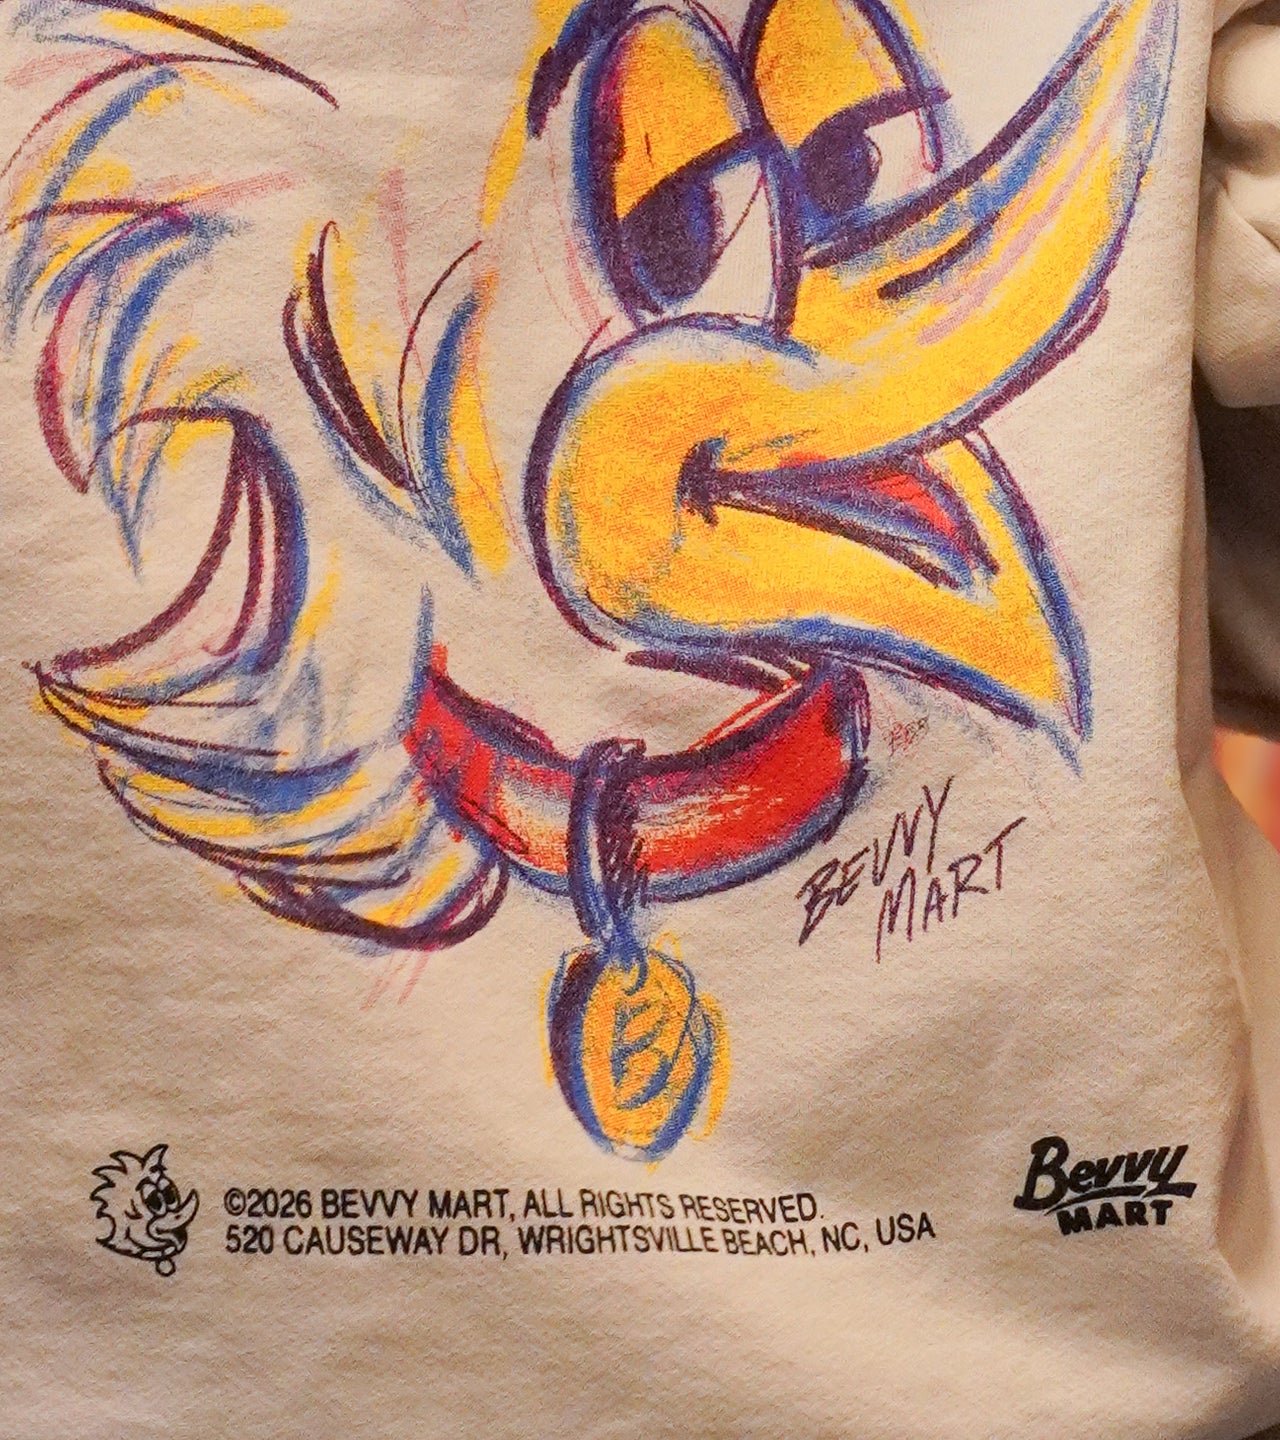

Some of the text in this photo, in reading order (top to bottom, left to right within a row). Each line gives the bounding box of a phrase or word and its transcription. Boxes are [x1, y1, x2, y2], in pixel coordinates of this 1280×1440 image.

[875, 816, 1027, 964] MART
[1013, 1135, 1197, 1215] Bevvy
[223, 1187, 825, 1224] ©2026 BEVVY MART, ALL RIGHTS RESERVED.
[1056, 1199, 1174, 1237] MART
[225, 1211, 937, 1261] 520 CAUSEWAY DR, WRIGHTSVILLE BEACH, NC, USA
